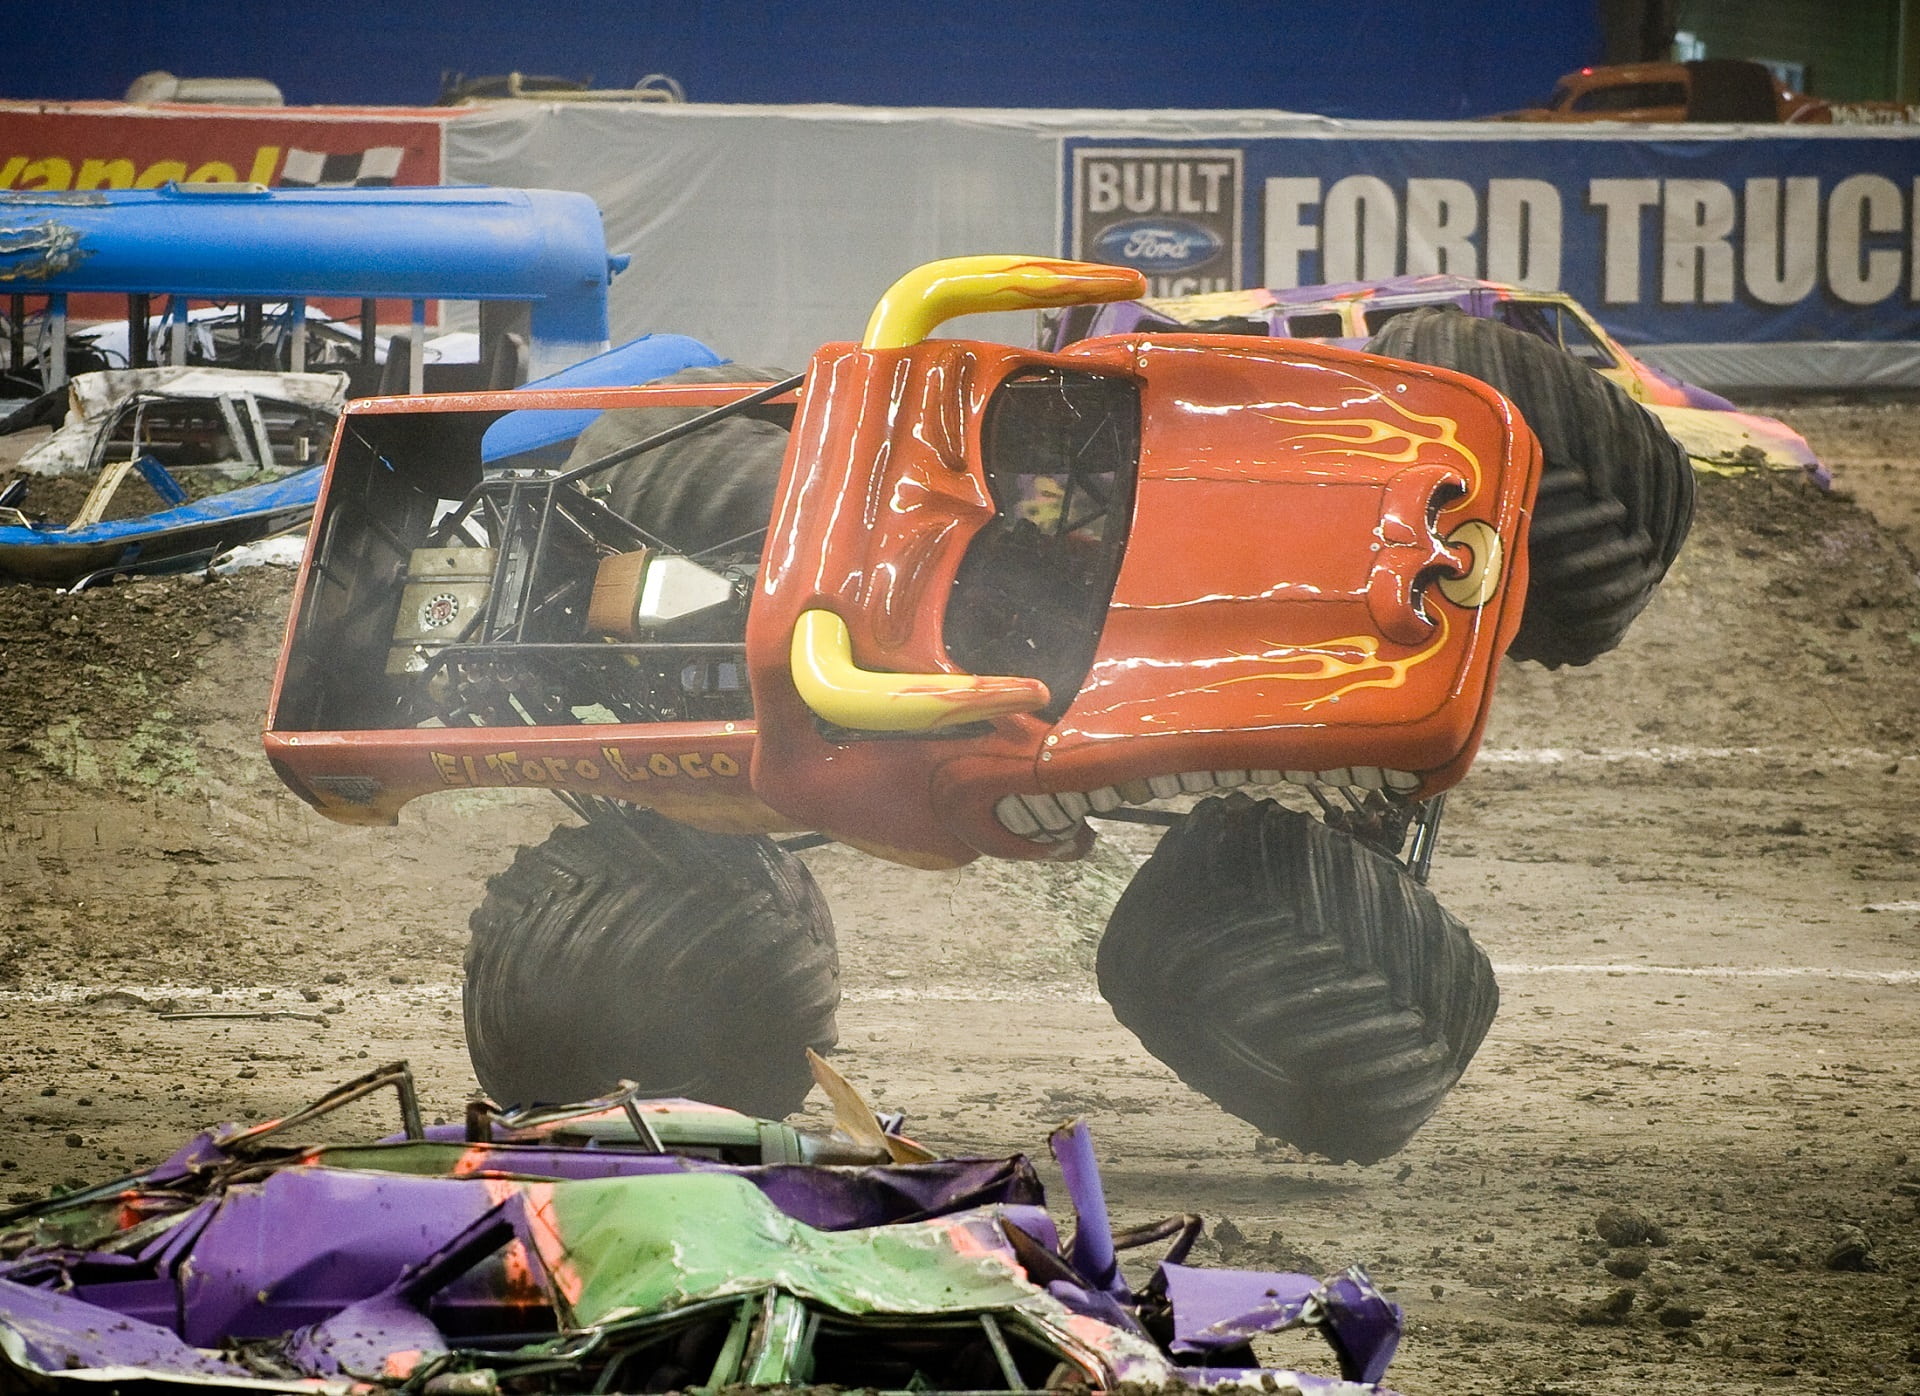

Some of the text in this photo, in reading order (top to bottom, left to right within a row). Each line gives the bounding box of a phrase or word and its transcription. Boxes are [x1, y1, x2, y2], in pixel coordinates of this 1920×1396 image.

[1088, 162, 1231, 213] BUILT
[1123, 229, 1190, 260] Ford
[1264, 173, 1920, 305] FORD TRUC
[430, 747, 740, 786] El Toro Loco
